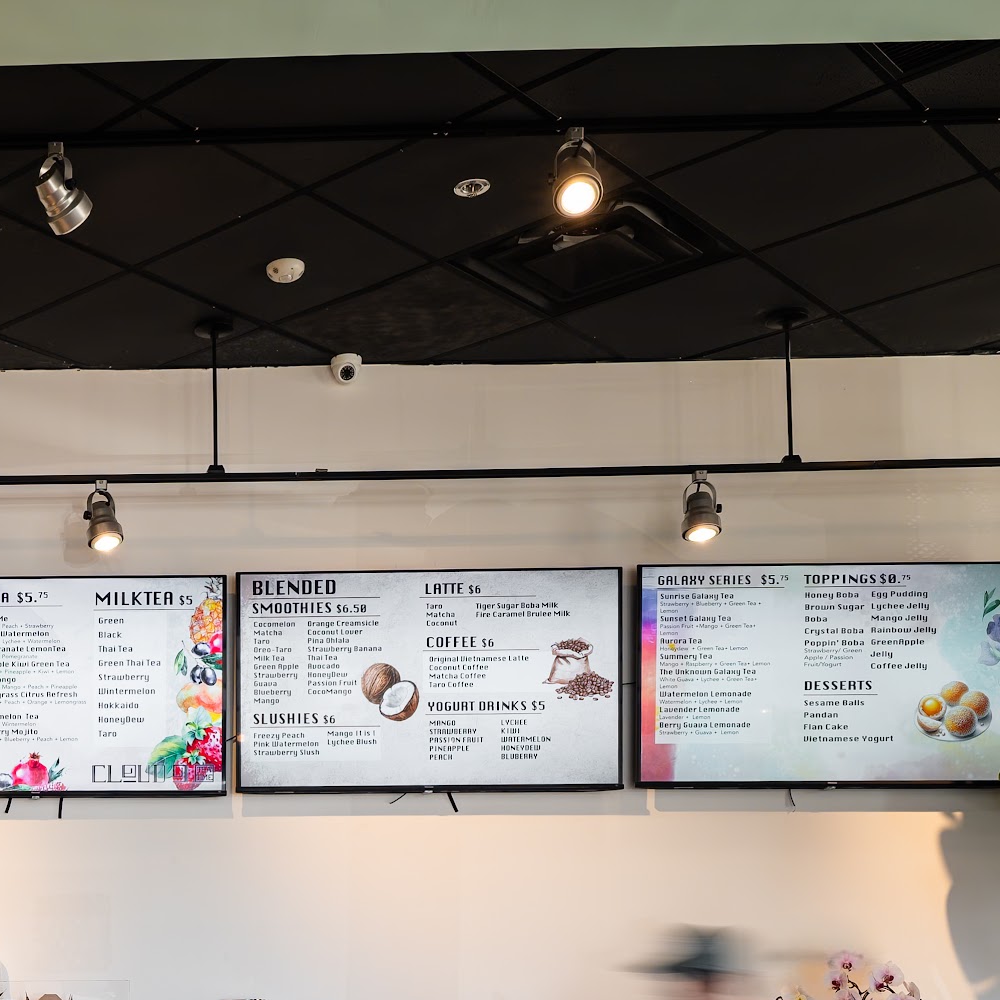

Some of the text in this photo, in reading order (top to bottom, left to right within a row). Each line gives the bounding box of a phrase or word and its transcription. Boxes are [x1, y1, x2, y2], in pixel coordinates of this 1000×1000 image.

[658, 575, 705, 585] GALAXY
[709, 575, 751, 585] SERIES
[804, 574, 876, 584] TOPPINGS
[252, 580, 336, 595] BLENDED
[425, 583, 481, 594] LATTE $6
[96, 592, 192, 606] MILKTEA $5
[872, 591, 887, 599] Egg
[253, 602, 366, 614] SMOOTHIES $6.50
[871, 603, 904, 611] Lychee
[689, 615, 716, 623] Galaxy
[805, 628, 838, 636] Crystal
[427, 636, 494, 648] COFFEE $6
[870, 651, 893, 659] Jelly
[98, 674, 149, 682] Strawberry
[805, 681, 872, 690] DESSERTS
[428, 700, 545, 711] YOGURT DRINKS $5
[253, 713, 335, 724] SLUSHIES $6
[659, 722, 681, 730] Berry
